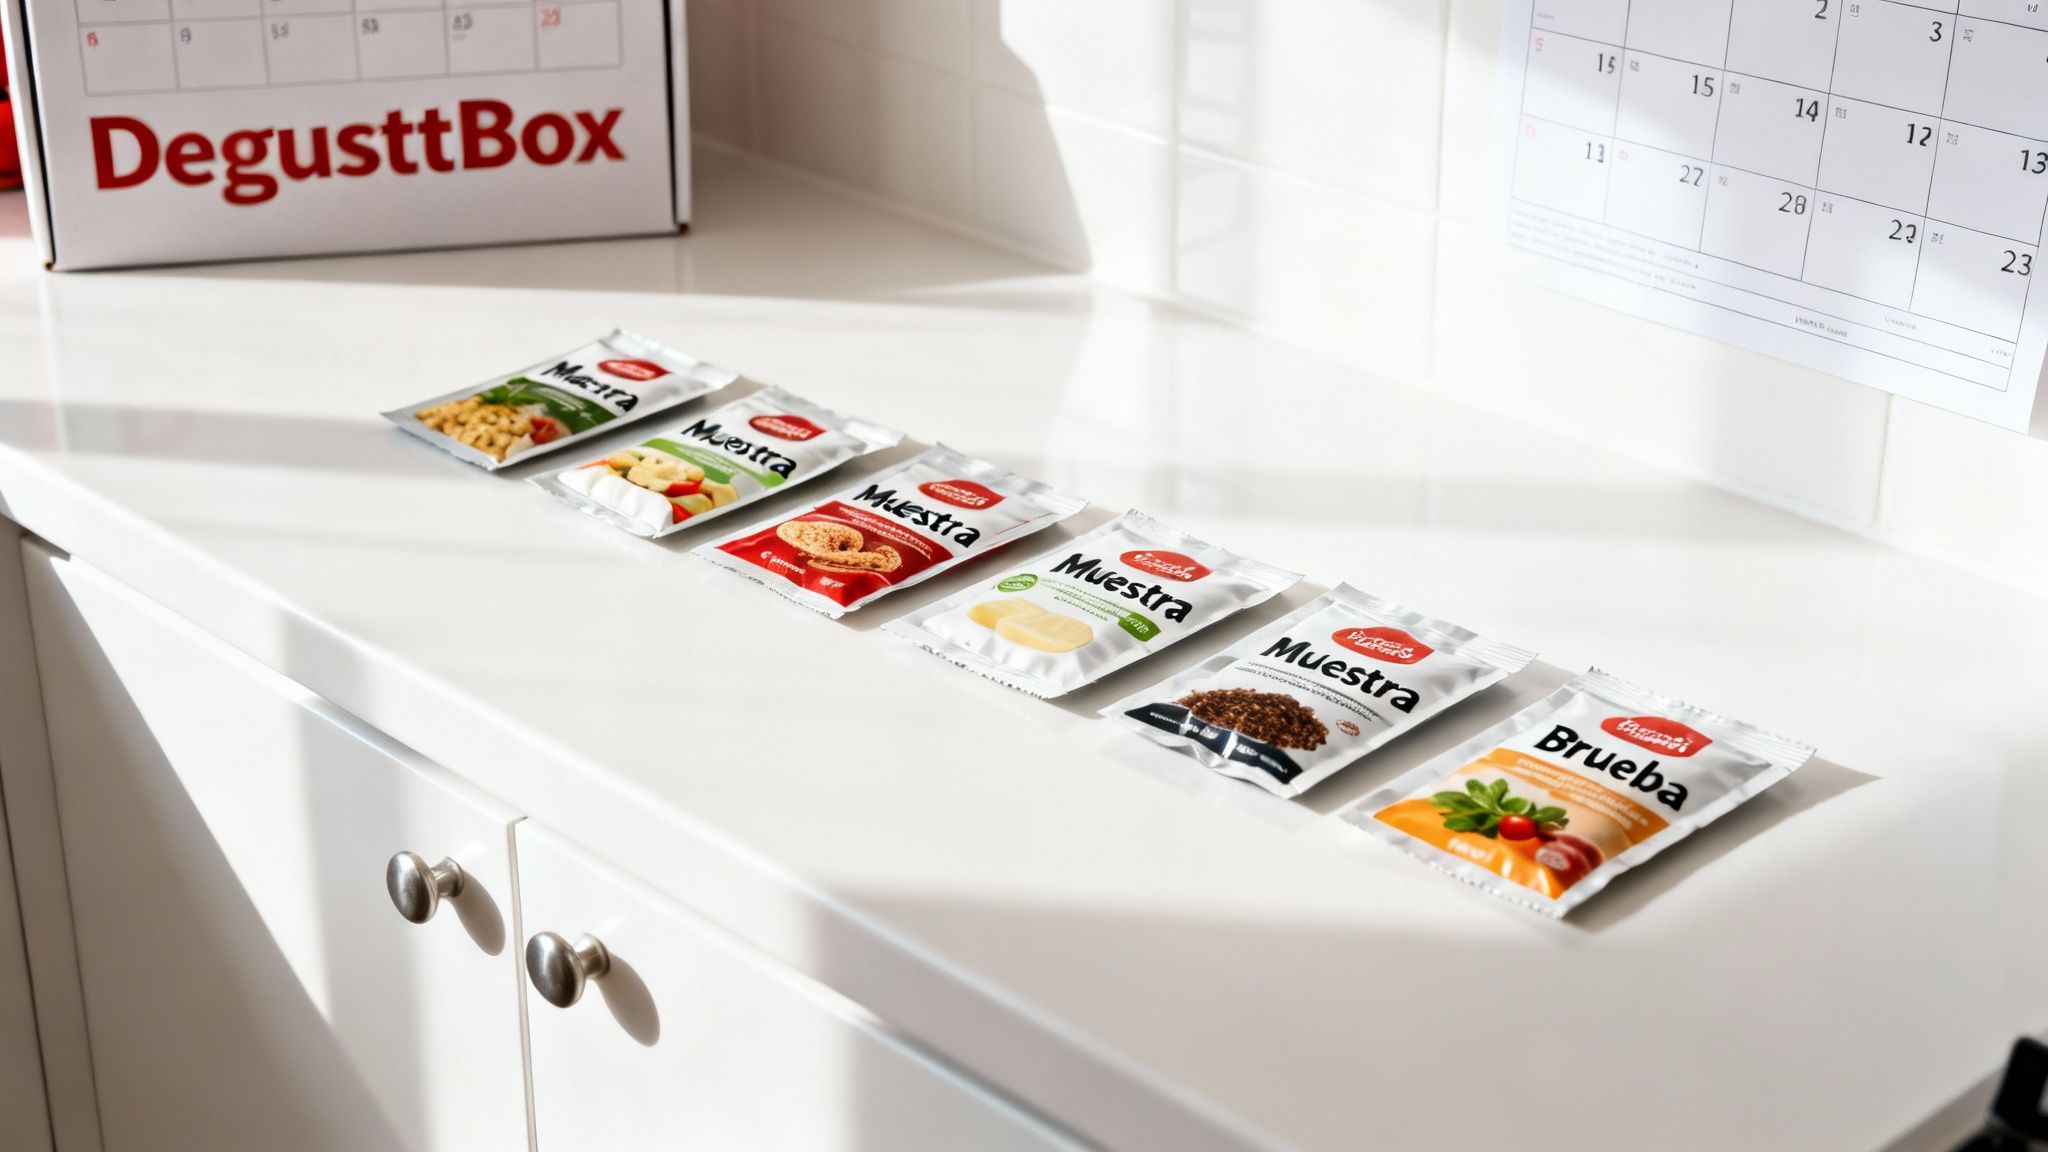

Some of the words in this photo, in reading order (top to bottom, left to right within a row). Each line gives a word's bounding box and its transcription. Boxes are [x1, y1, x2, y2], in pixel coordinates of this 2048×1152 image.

[1929, 21, 1943, 42] 3
[1692, 74, 1715, 98] 15
[1795, 98, 1819, 122] 14
[1907, 123, 1932, 147] 12
[90, 99, 625, 206] DegusttBox
[2020, 149, 2048, 175] 13
[2000, 250, 2033, 276] 23
[853, 483, 982, 548] Muestra
[1050, 553, 1194, 623] Muestra
[1259, 636, 1421, 714] Muestra
[1533, 724, 1689, 811] Brueba
